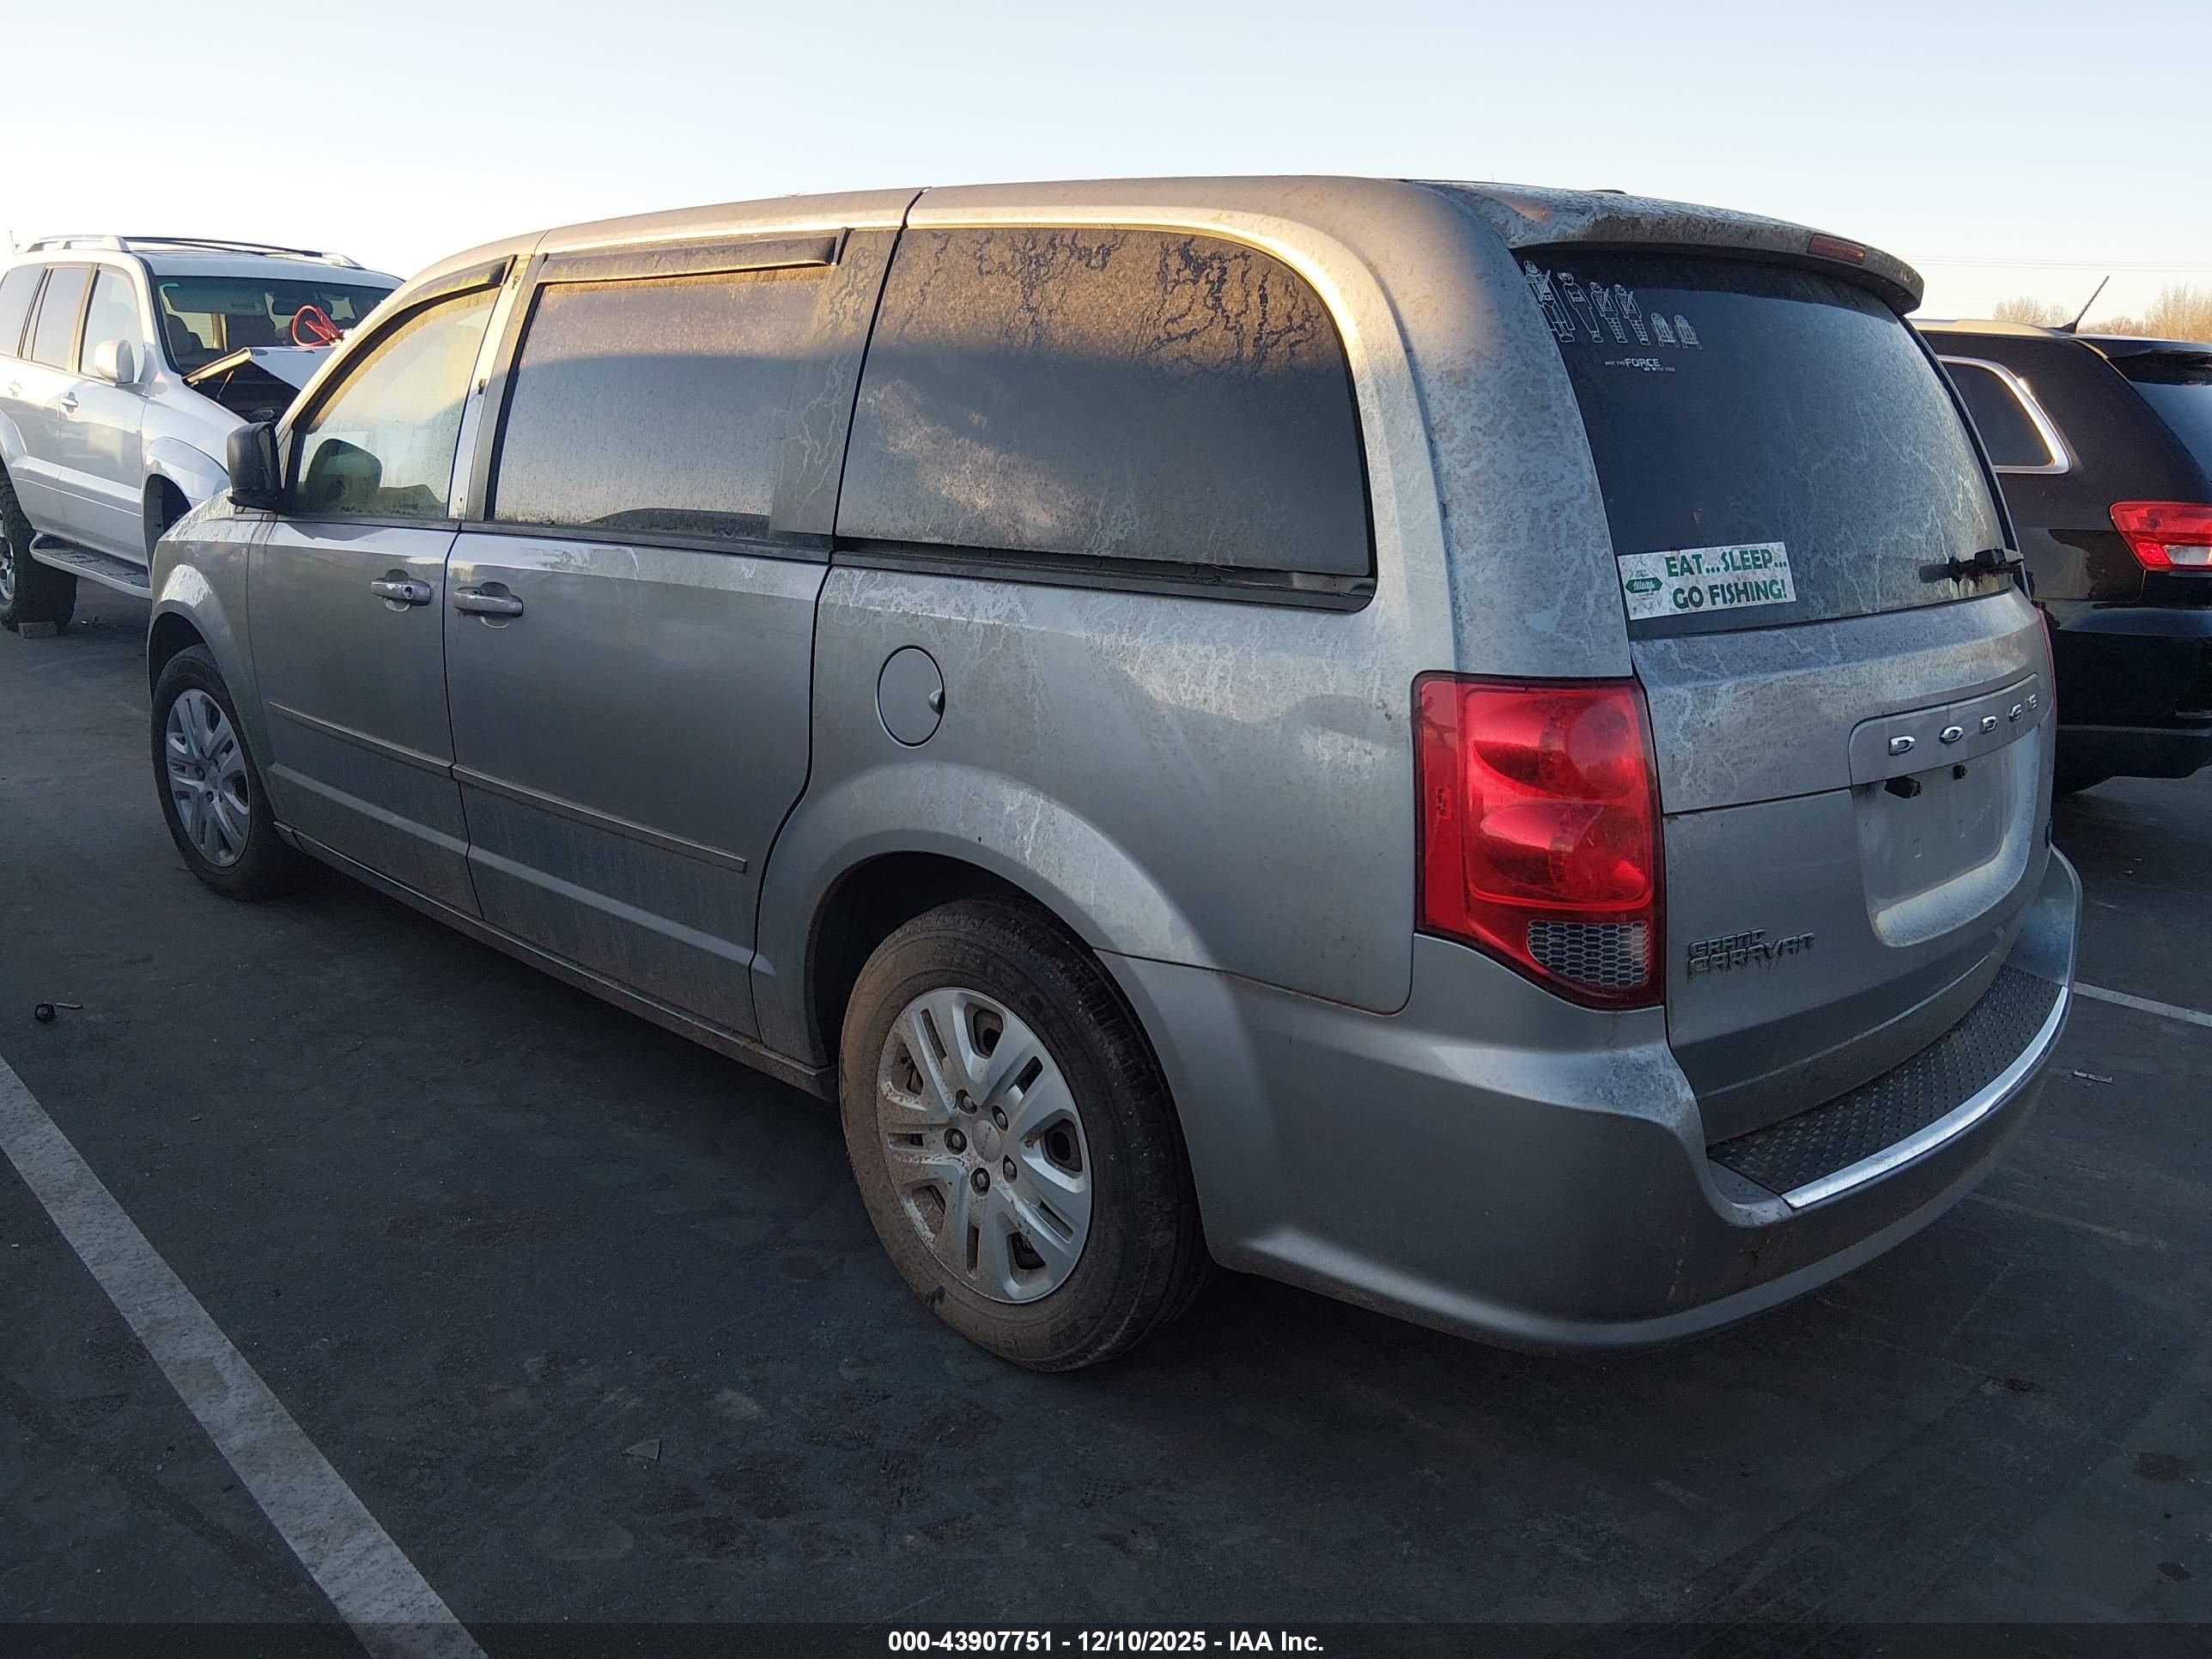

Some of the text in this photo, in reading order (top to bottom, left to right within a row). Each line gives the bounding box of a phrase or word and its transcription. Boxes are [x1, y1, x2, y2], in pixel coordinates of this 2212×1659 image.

[1625, 358, 1661, 368] FORCE
[1673, 579, 1788, 610] GO FISHING!
[1889, 693, 2038, 756] DODGE
